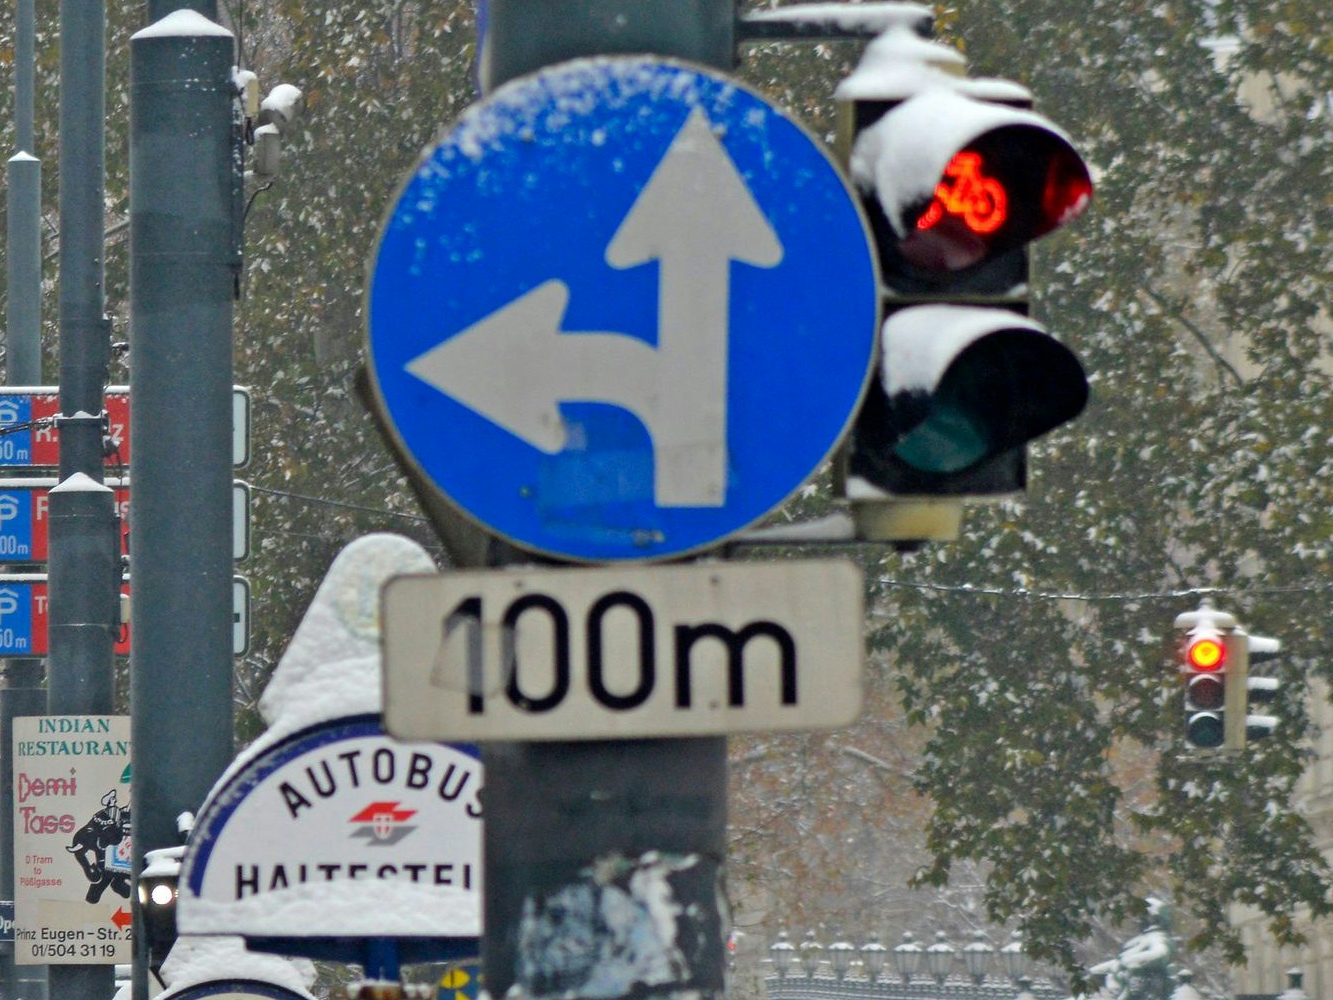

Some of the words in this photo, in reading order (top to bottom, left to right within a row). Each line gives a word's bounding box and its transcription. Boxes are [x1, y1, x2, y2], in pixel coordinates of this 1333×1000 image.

[38, 719, 111, 733] INDIAN
[18, 741, 132, 756] RESTAURAN
[18, 767, 77, 803] Demi
[19, 806, 76, 834] Tass
[33, 855, 53, 864] Tram
[17, 928, 36, 941] Prinz
[31, 944, 76, 958] 01/504
